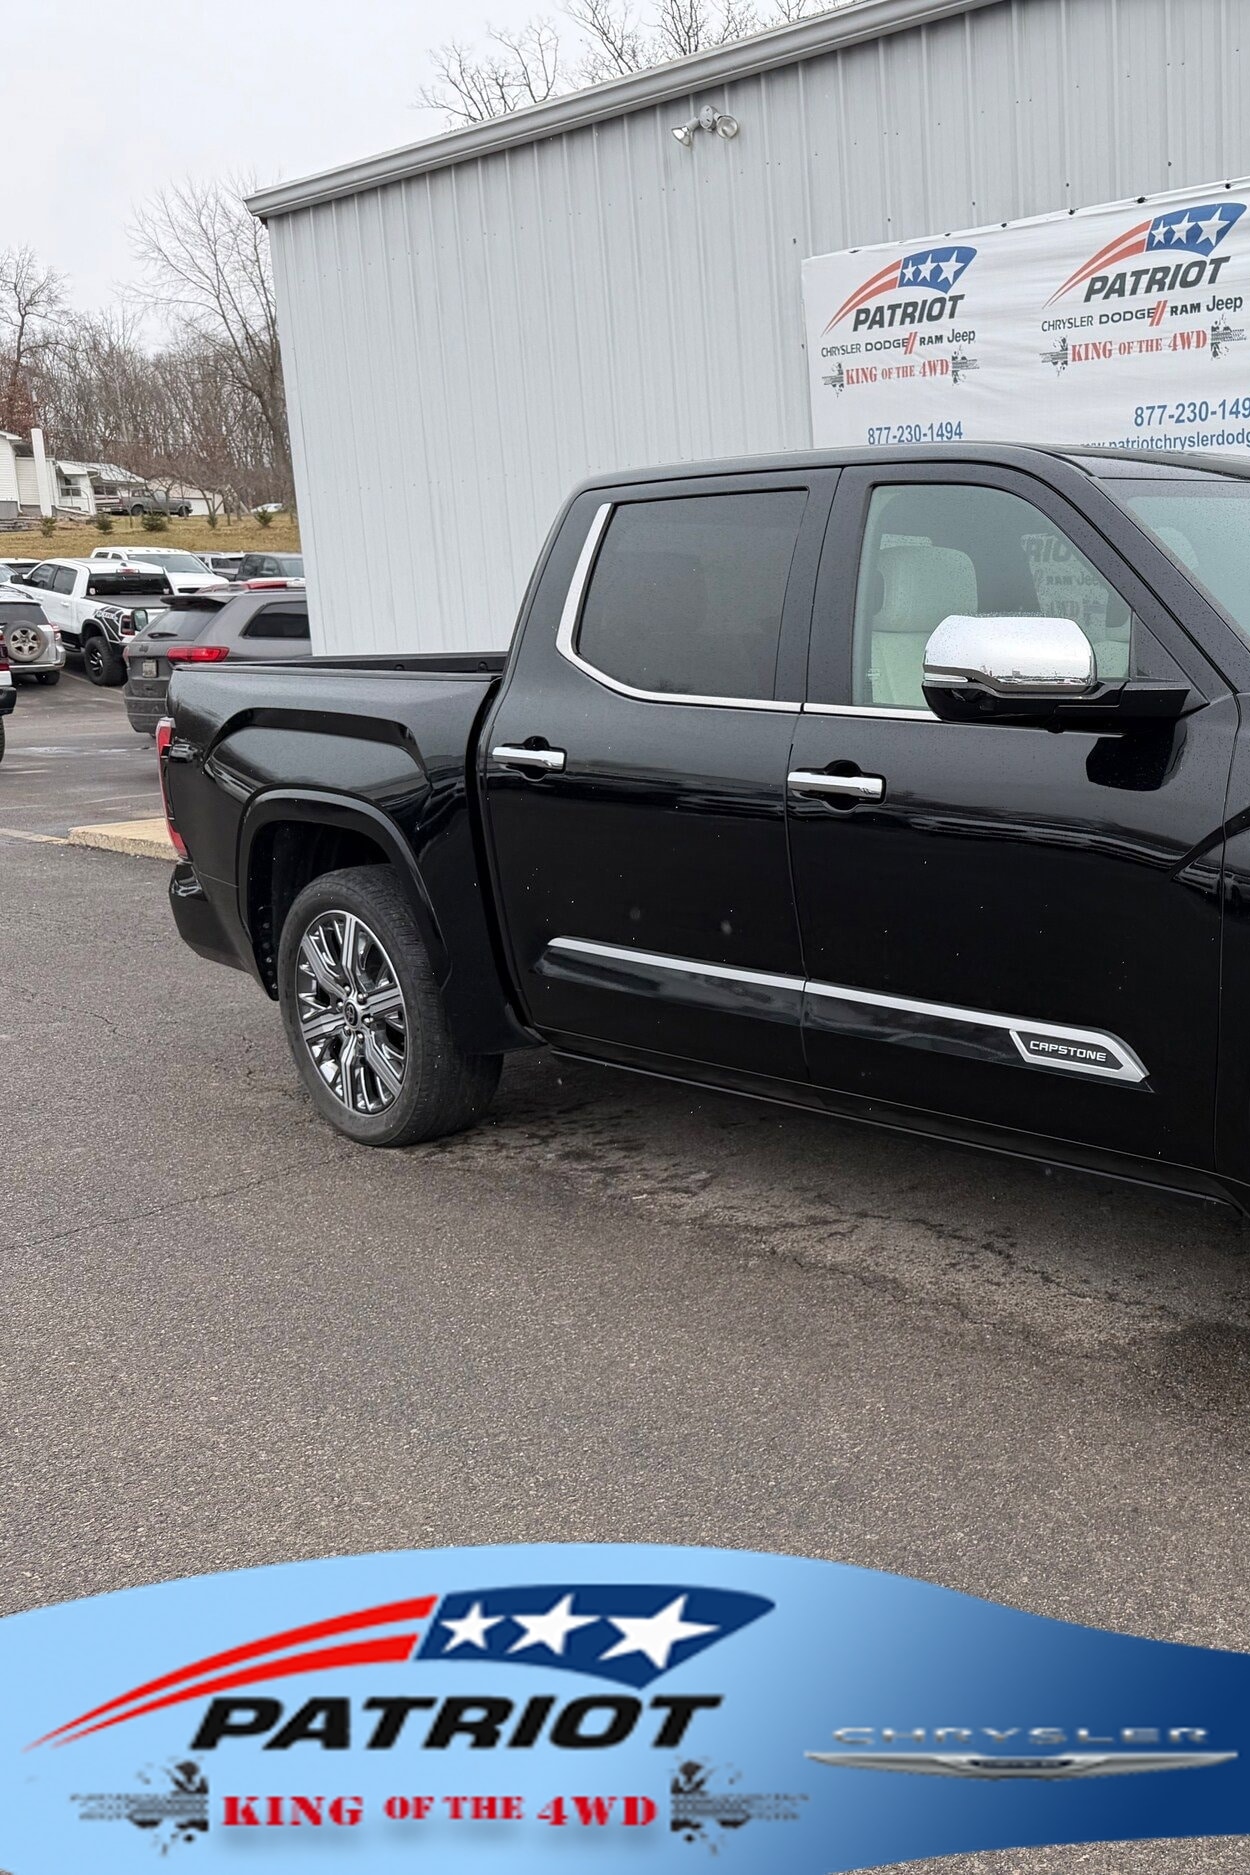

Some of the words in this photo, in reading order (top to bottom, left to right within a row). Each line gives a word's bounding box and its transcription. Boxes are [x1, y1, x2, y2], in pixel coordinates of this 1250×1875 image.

[1084, 256, 1231, 302] PATRIOT
[853, 294, 965, 332] PATRIOT
[1041, 316, 1094, 332] CHRYSLER
[1099, 308, 1155, 324] DODGE
[1170, 302, 1200, 316] RAM
[1206, 295, 1243, 313] Jeep
[821, 343, 861, 357] CHRYSLER
[865, 338, 908, 351] DODGE
[920, 334, 943, 346] RAM
[948, 329, 976, 344] Jeep
[1071, 341, 1113, 362] KING
[1118, 342, 1135, 355] OF
[1135, 338, 1162, 354] THE
[1168, 330, 1208, 351] 4WD
[846, 366, 878, 385] KING
[882, 368, 895, 380] OF
[895, 365, 915, 378] THE
[919, 359, 950, 377] 4WD
[868, 421, 963, 445] 877-230-1494
[1030, 1040, 1106, 1062] CAPSTONE
